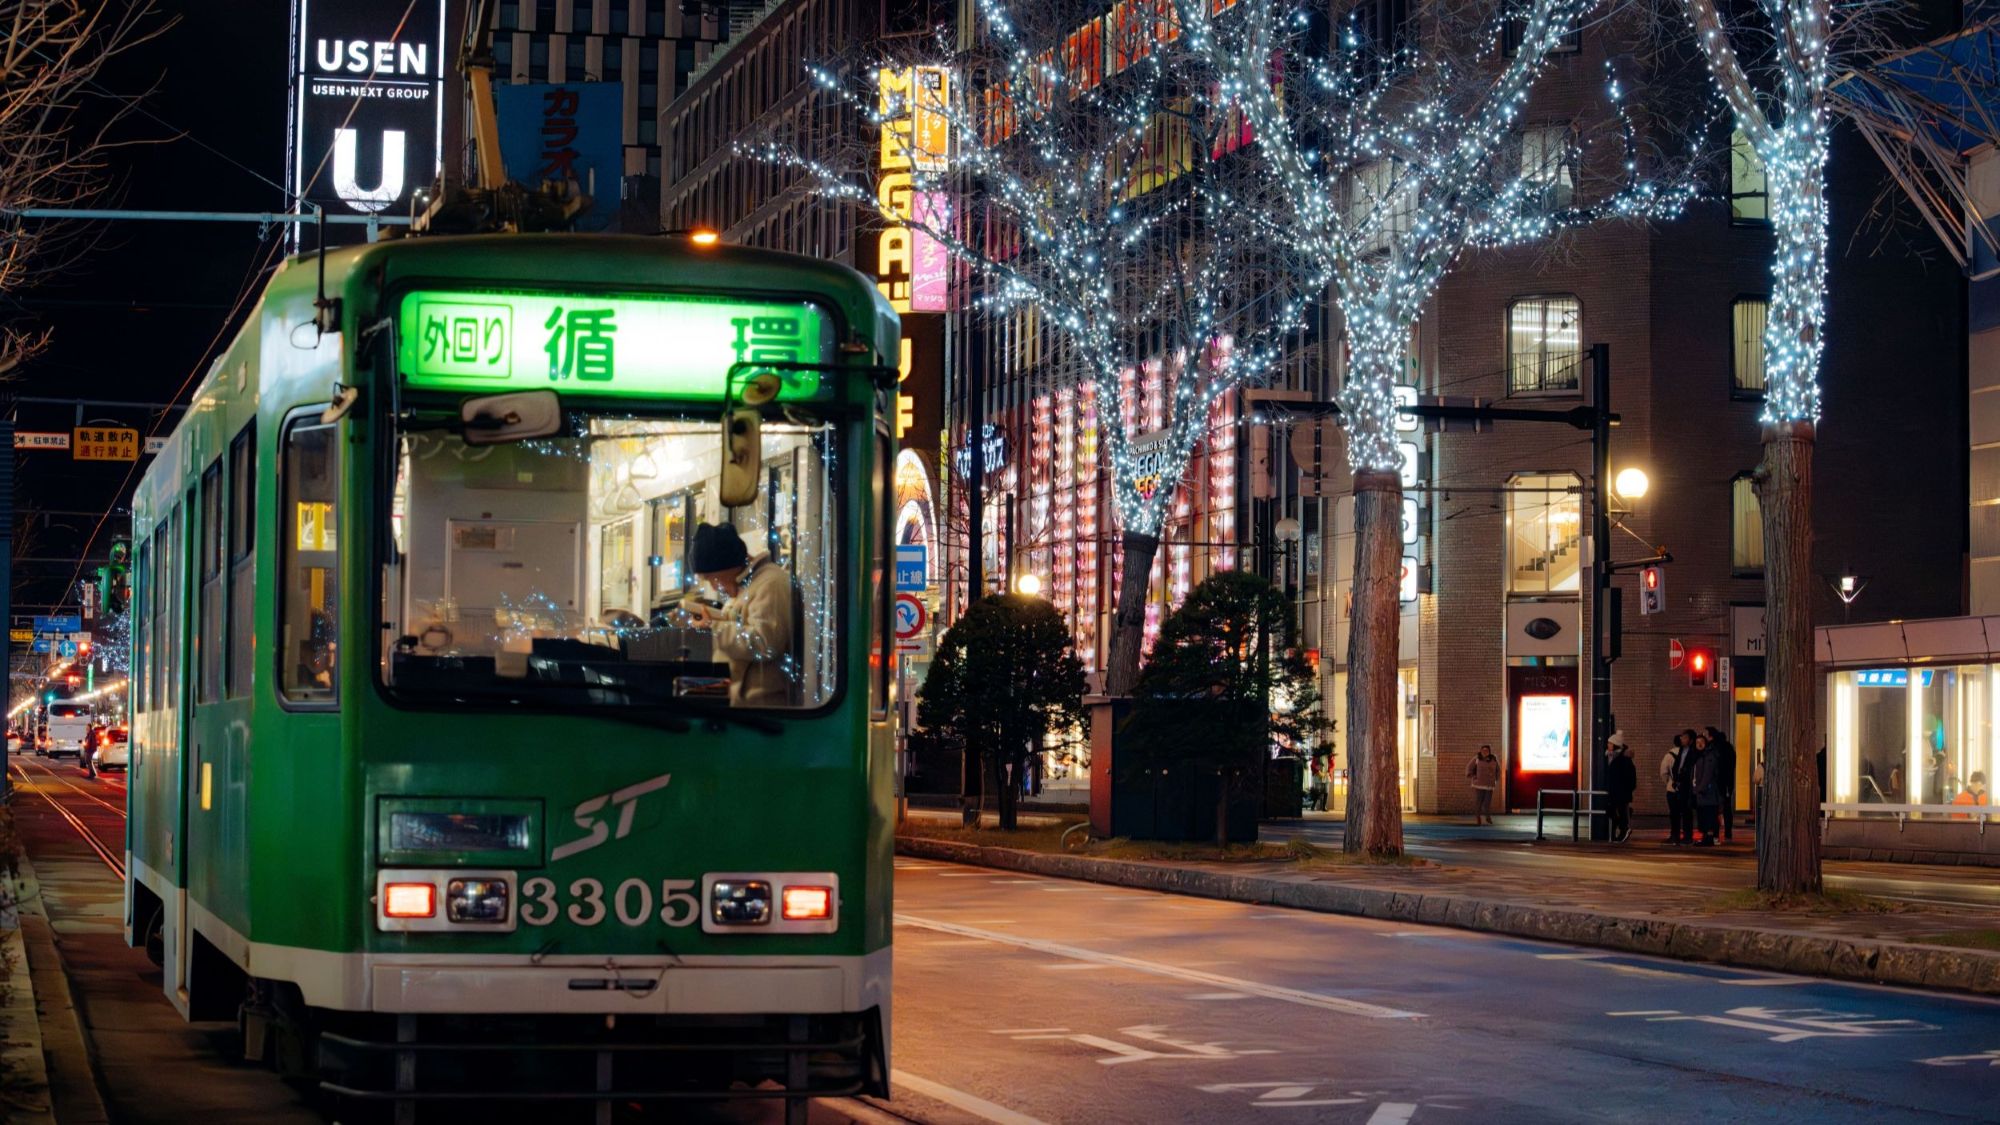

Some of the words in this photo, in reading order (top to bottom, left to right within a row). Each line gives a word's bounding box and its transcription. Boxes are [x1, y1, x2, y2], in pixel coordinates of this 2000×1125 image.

[317, 39, 427, 75] USEN
[312, 85, 383, 98] USEN-NEXT
[387, 88, 430, 99] GROUP
[333, 128, 406, 213] U
[423, 314, 504, 366] 外回り
[79, 431, 133, 443] 軌道敷内
[80, 445, 132, 458] 通行禁止
[551, 773, 671, 862] ST
[521, 877, 700, 927] 3305
